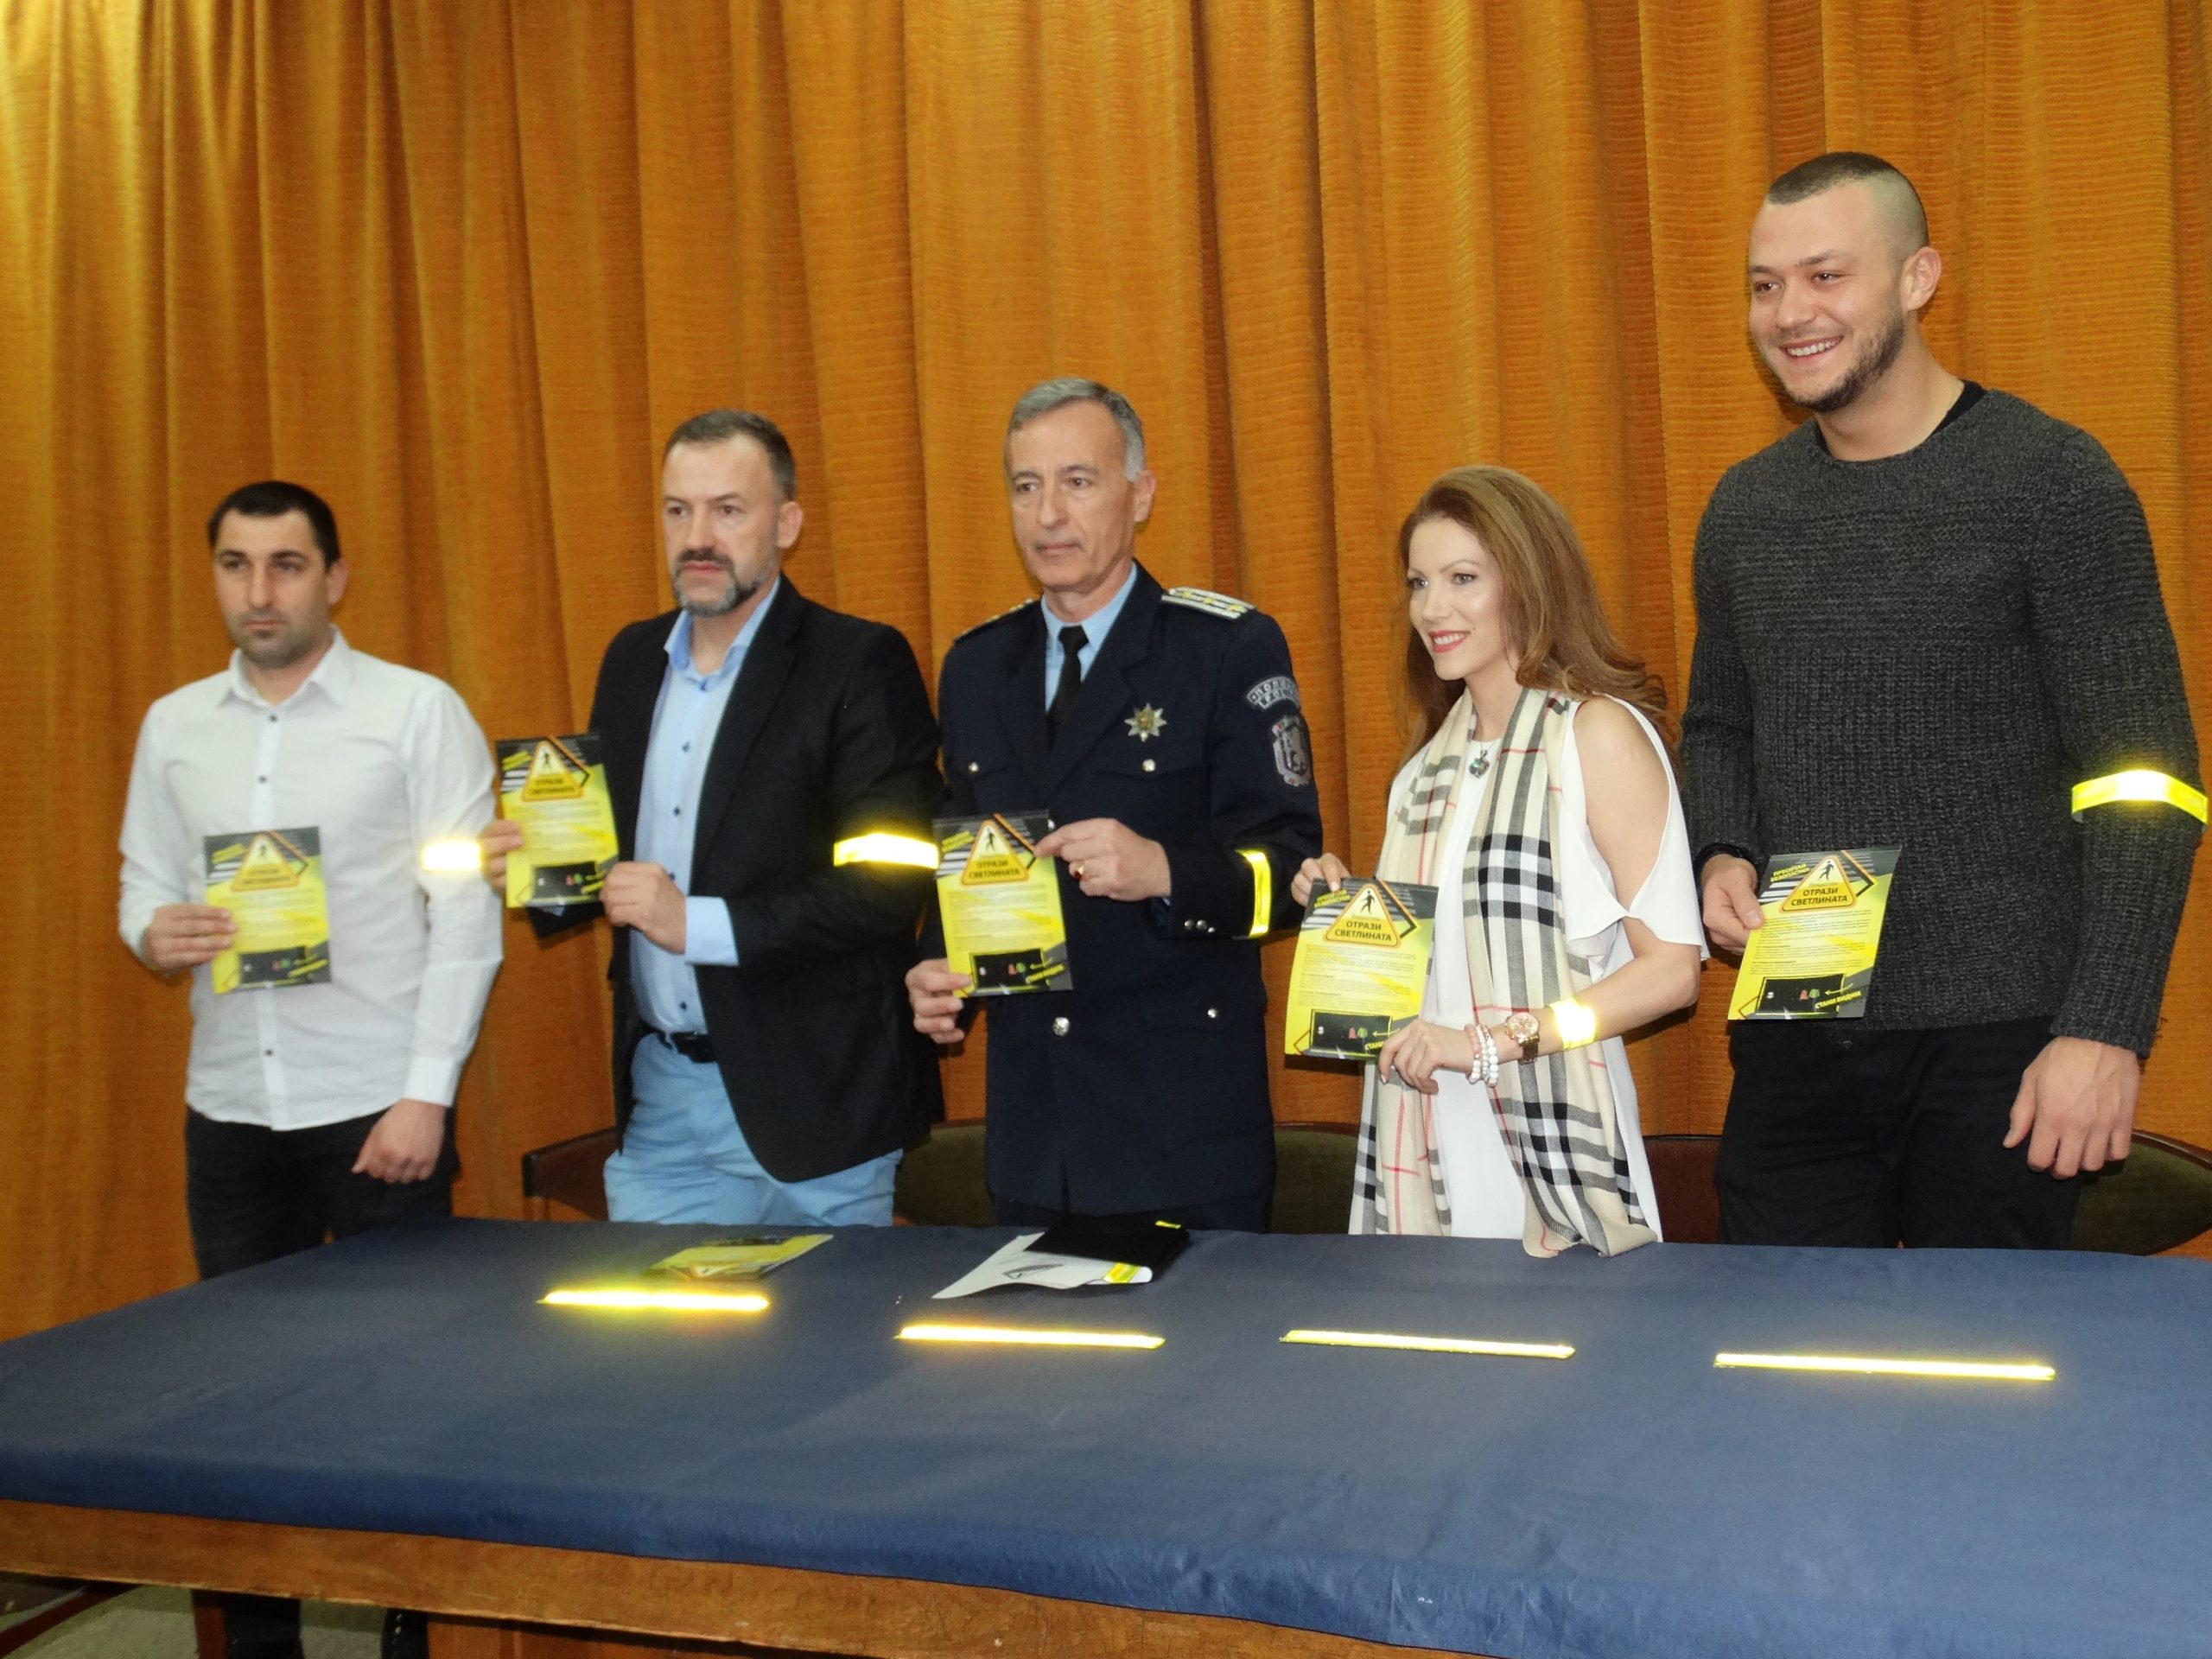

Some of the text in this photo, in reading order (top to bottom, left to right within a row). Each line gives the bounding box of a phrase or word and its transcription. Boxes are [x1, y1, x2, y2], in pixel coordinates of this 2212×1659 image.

[976, 859, 1008, 869] ОТРАЗИ
[969, 869, 1020, 880] СВЕТЛИНАТА
[1802, 887, 1839, 897] ОТРАЗИ
[1790, 895, 1847, 906] СВЕТЛИНАТА
[1345, 920, 1382, 931] ОТРАЗИ
[1334, 929, 1392, 942] СВЕТЛИНАТА
